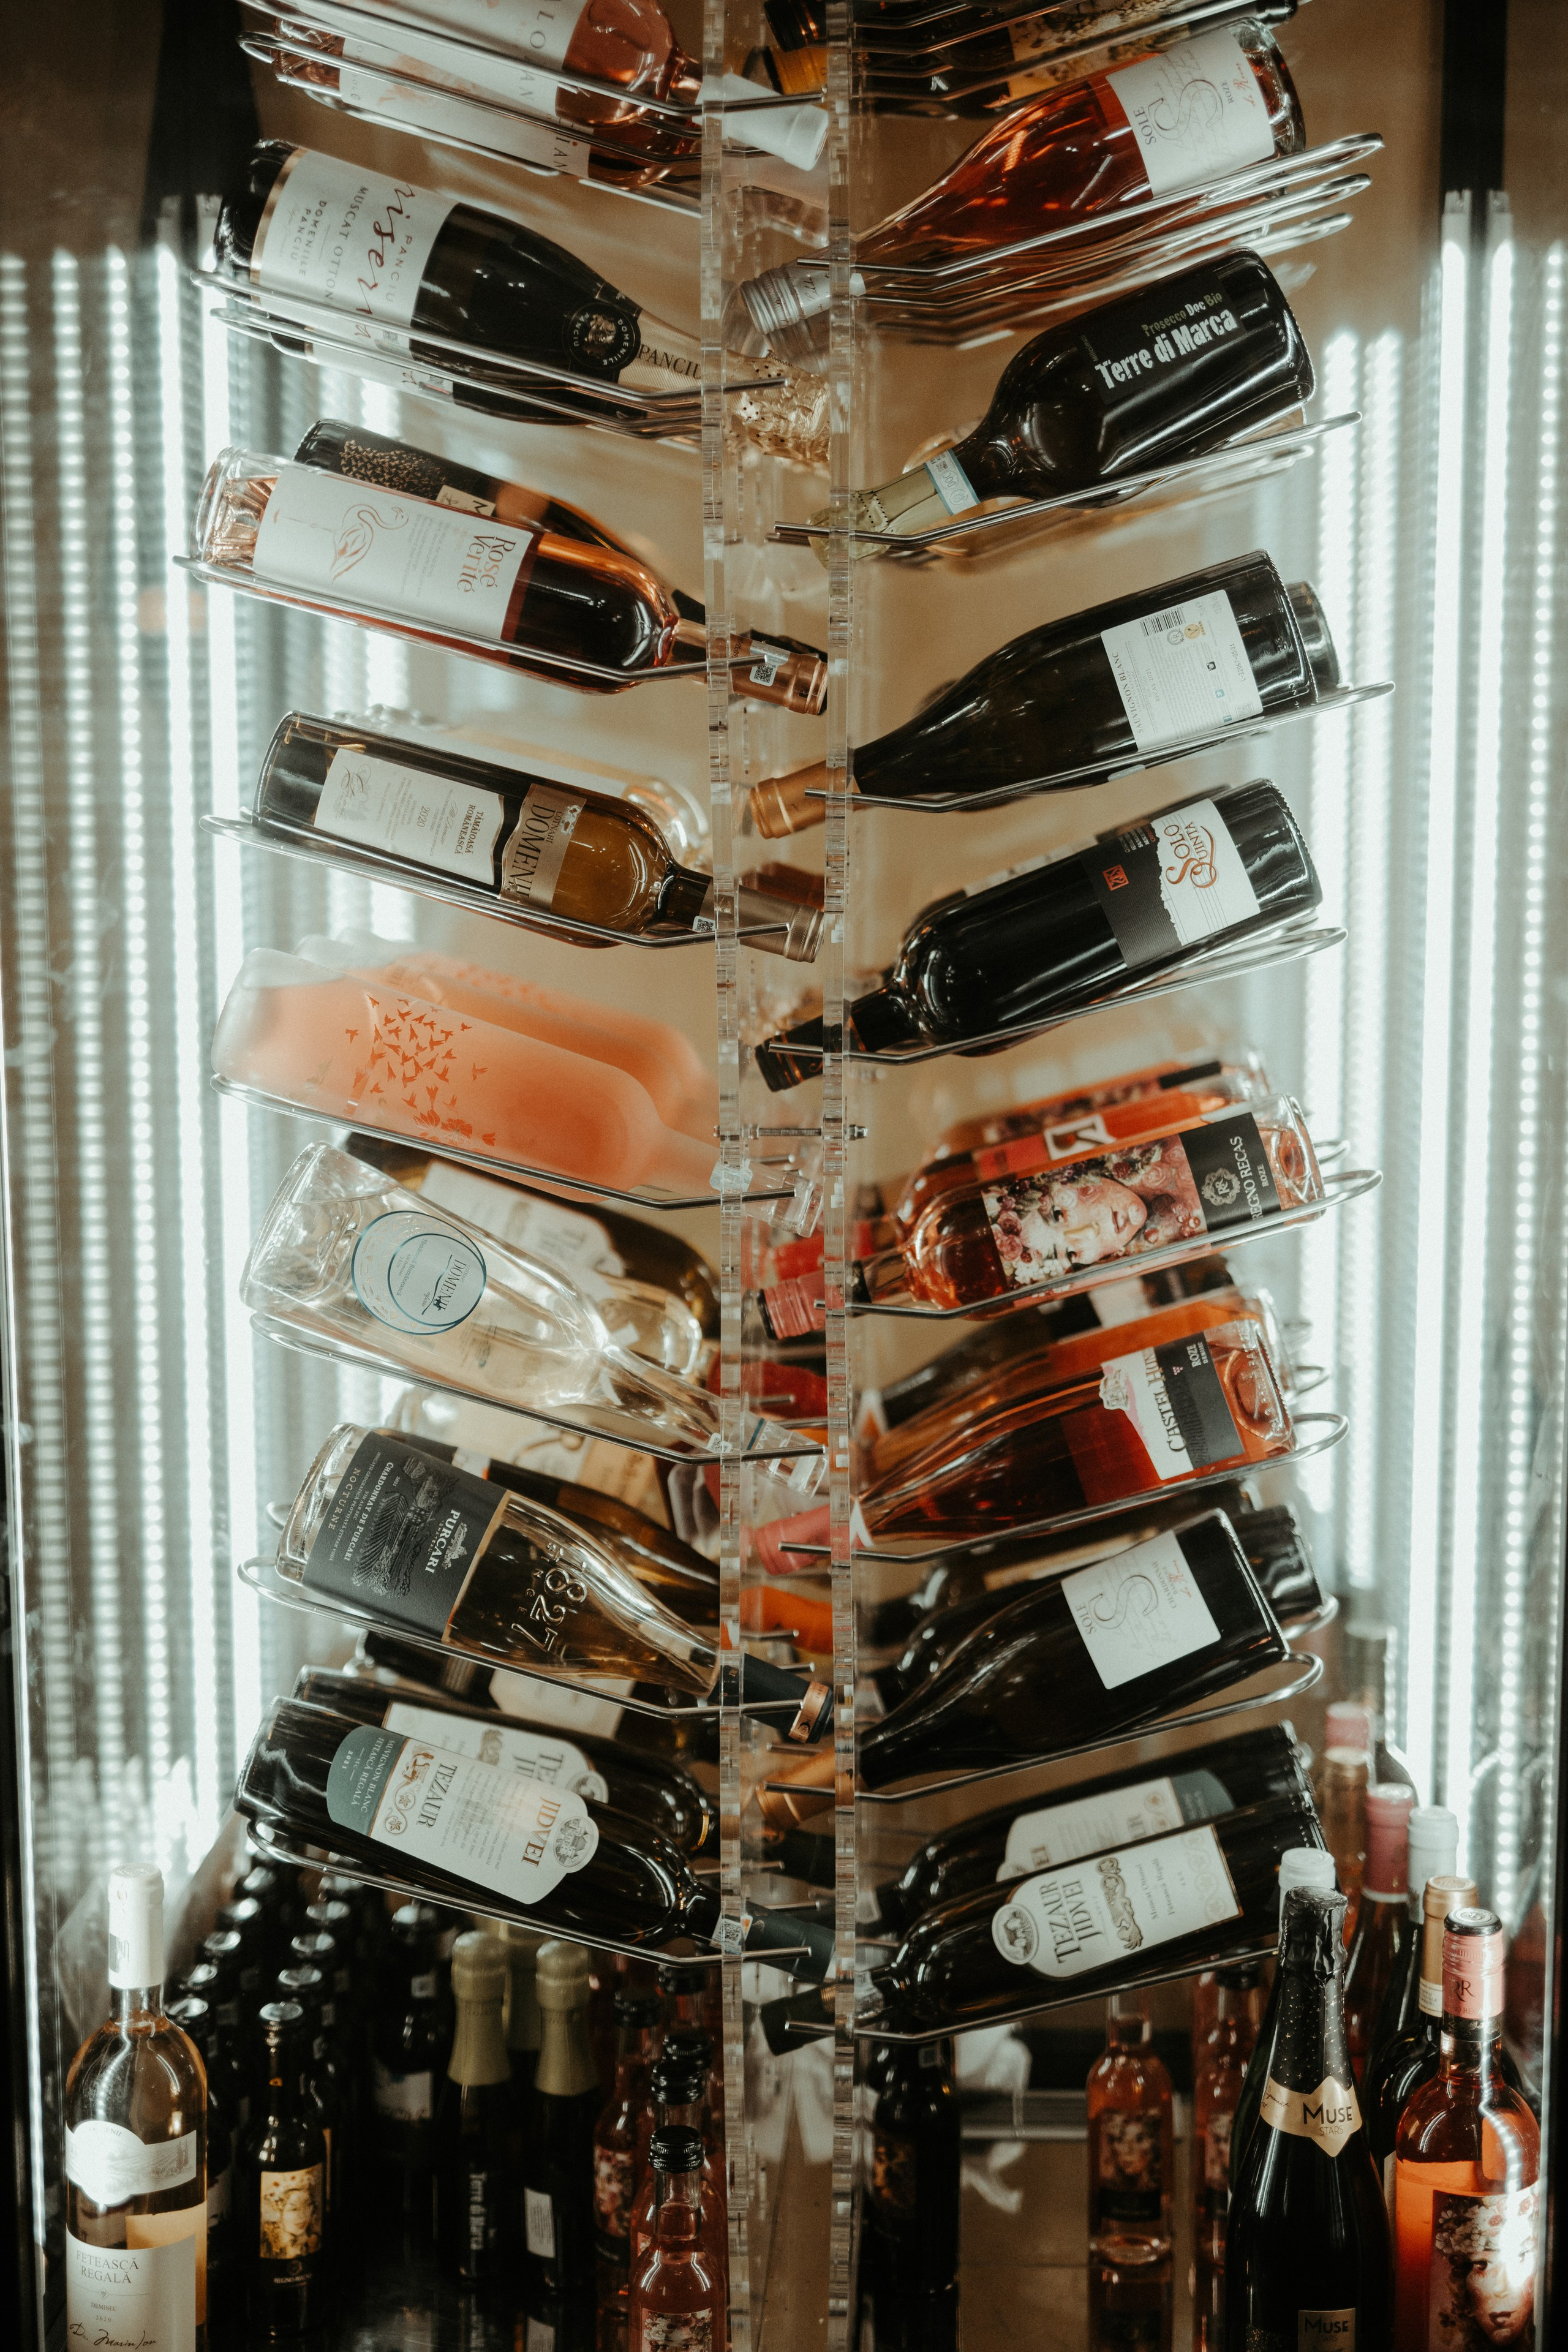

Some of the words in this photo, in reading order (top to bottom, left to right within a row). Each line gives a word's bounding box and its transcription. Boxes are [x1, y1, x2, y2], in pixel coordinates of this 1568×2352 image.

[1219, 81, 1235, 105] ROZE
[1133, 106, 1156, 146] SOLE
[338, 186, 369, 240] MUSCAT
[290, 208, 311, 261] PANCIU
[298, 199, 328, 277] DOMENIILE
[385, 234, 413, 303] PANCIU
[573, 311, 590, 347] PANCIU
[1141, 308, 1187, 337] Prosecco
[1185, 300, 1206, 317] Doc
[1204, 292, 1223, 307] Bio
[602, 318, 630, 366] DOMENIILE
[1095, 347, 1154, 389] Terre
[1154, 333, 1176, 363] di
[1170, 309, 1238, 356] Marca
[454, 530, 495, 595] Verité
[478, 536, 516, 590] Rosé
[1111, 650, 1127, 682] BLANC
[1145, 667, 1153, 681] 2021
[1121, 682, 1144, 734] SAUVIGNON
[415, 805, 431, 828] 2020
[464, 810, 484, 854] TĂMÂIOASĂ
[546, 810, 563, 843] COTNARI
[1163, 824, 1202, 885] SOLO
[1185, 821, 1217, 889] QUINTA
[1256, 1163, 1269, 1187] ROZE
[395, 1256, 404, 1268] 2020
[459, 1264, 471, 1283] COTNARI
[1186, 1343, 1202, 1368] ROZE
[1152, 1387, 1186, 1453] CASTEL
[327, 1467, 361, 1530] NOCTURNE
[363, 1461, 394, 1512] CHARDONNAY
[392, 1476, 401, 1487] 2021
[352, 1510, 360, 1520] SEC
[358, 1512, 368, 1525] DE
[343, 1525, 364, 1561] PURCARI
[424, 1509, 461, 1574] PURCARI
[1075, 1600, 1097, 1635] SOLE
[341, 1749, 353, 1770] 2021
[371, 1738, 396, 1782] SAUVIGNON
[350, 1771, 370, 1807] REGALĂ
[359, 1782, 376, 1813] BLANC
[417, 1762, 458, 1830] TEZAUR
[521, 1795, 563, 1869] JIDVEI
[1038, 1880, 1080, 1964] TEZAUR
[1302, 2101, 1352, 2125] MUSE
[1319, 2125, 1343, 2136] STARS
[76, 2249, 139, 2270] FETEASCĂ
[81, 2264, 131, 2283] REGALĂ
[91, 2301, 117, 2312] DEMISEC
[1303, 2316, 1349, 2334] MUSE
